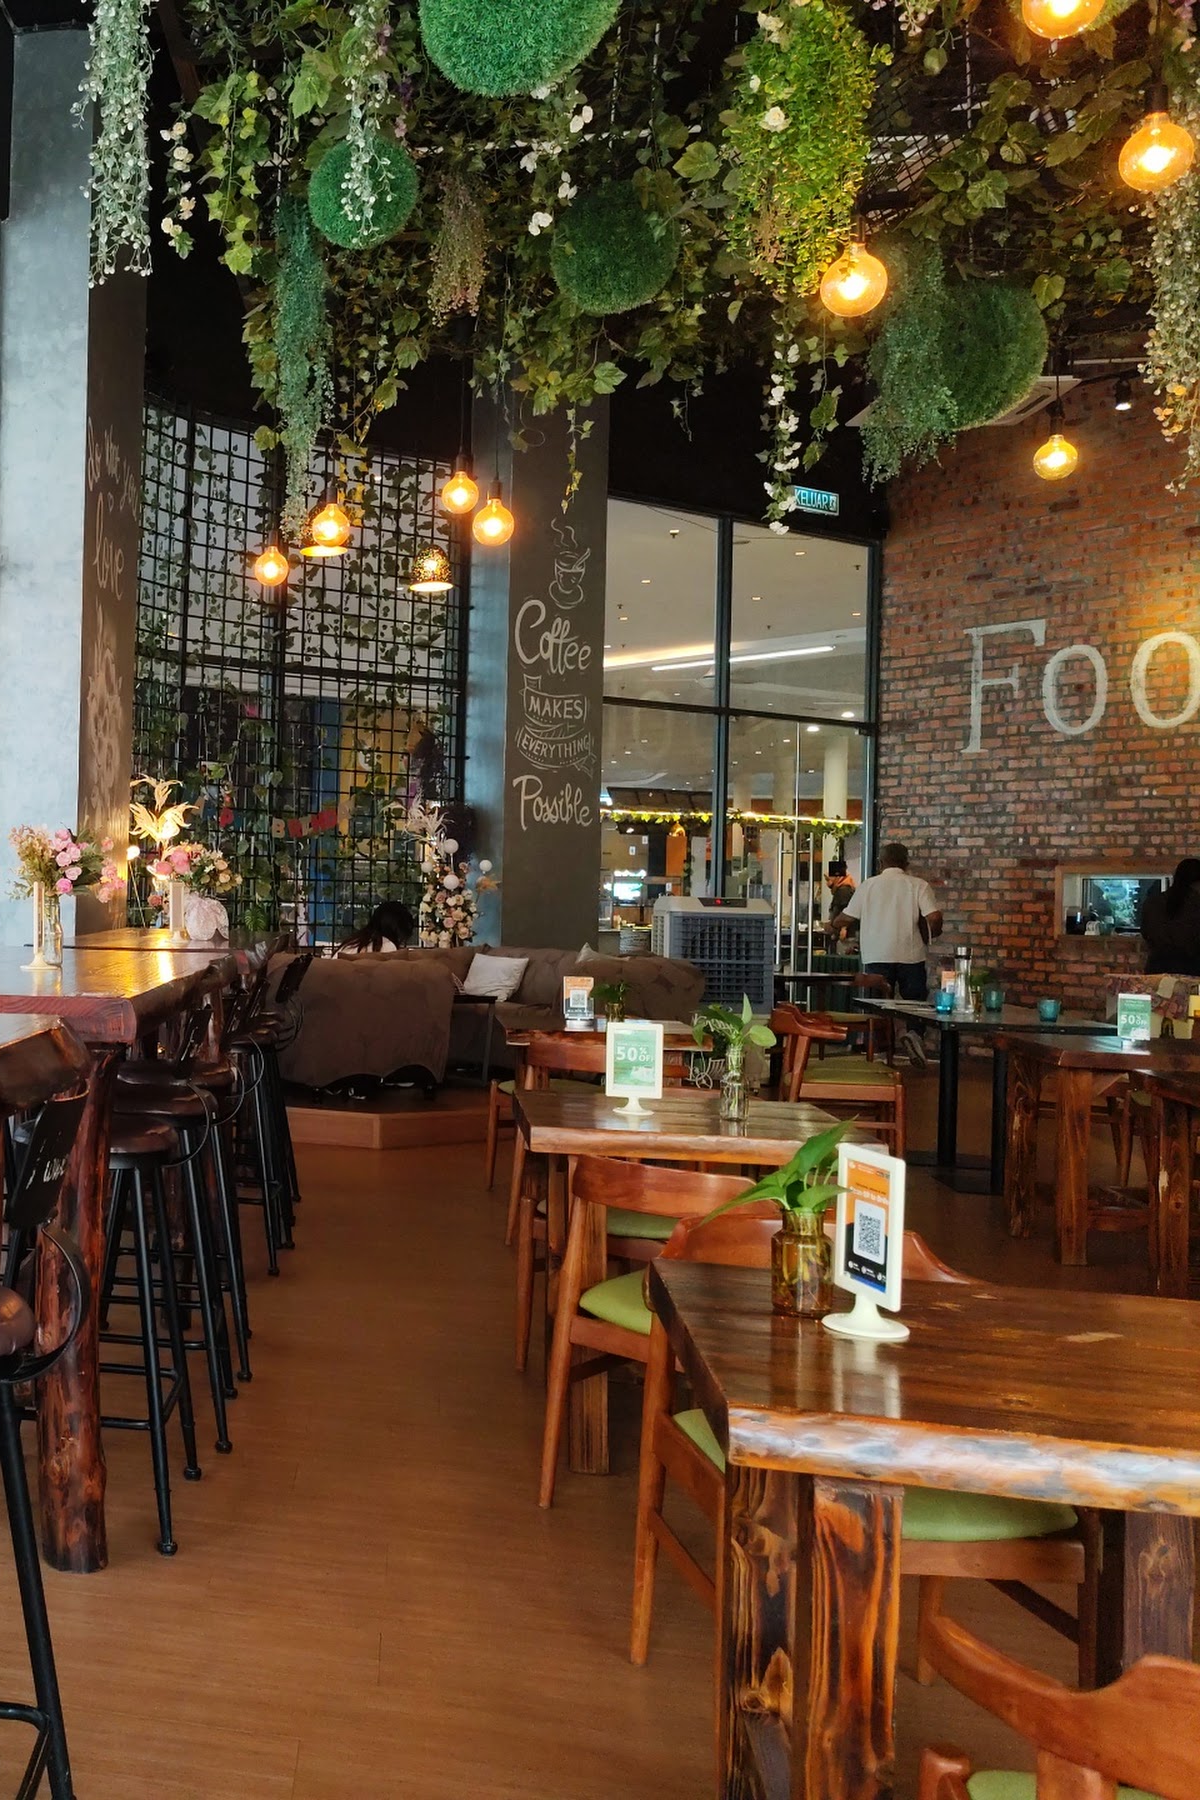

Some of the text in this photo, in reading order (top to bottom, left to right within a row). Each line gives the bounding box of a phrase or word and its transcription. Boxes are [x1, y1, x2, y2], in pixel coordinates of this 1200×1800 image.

[795, 488, 828, 510] KELUAR
[515, 599, 591, 675] Coffee
[528, 695, 584, 720] MAKES
[521, 733, 591, 759] EVERYTHING
[513, 774, 593, 831] Possible
